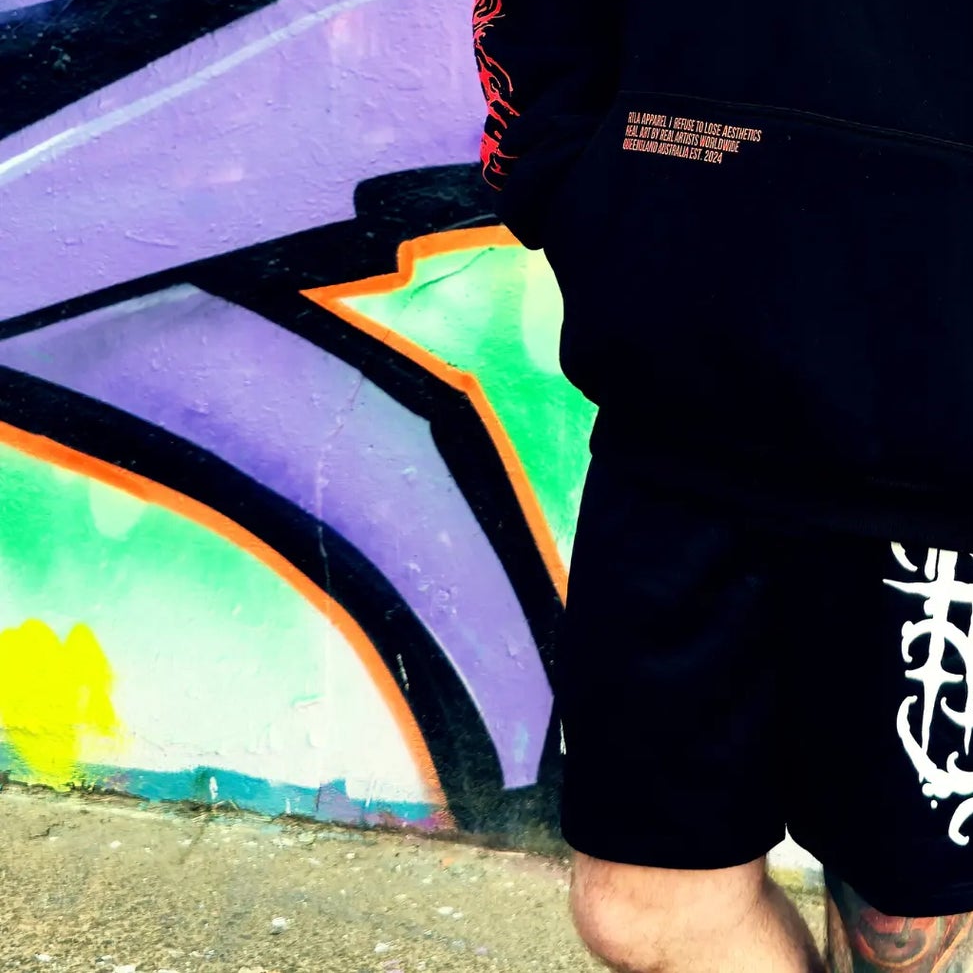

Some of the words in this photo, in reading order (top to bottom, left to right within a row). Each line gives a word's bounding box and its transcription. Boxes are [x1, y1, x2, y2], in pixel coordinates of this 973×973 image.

[625, 124, 639, 138] REAL
[639, 126, 652, 139] ART
[651, 128, 660, 140] BY
[659, 129, 675, 143] REAL
[674, 131, 700, 146] ARTISTS
[700, 134, 741, 153] WORLDWIDE
[641, 112, 667, 128] APPAREL
[673, 117, 696, 132] REFUSE
[696, 120, 704, 133] TO
[704, 121, 722, 136] LOSE
[722, 125, 762, 142] AESTHETICS
[622, 138, 659, 153] QUEENSLAND
[657, 142, 689, 159] AUSTRALIA
[689, 147, 703, 161] EST.
[704, 149, 723, 164] 2024
